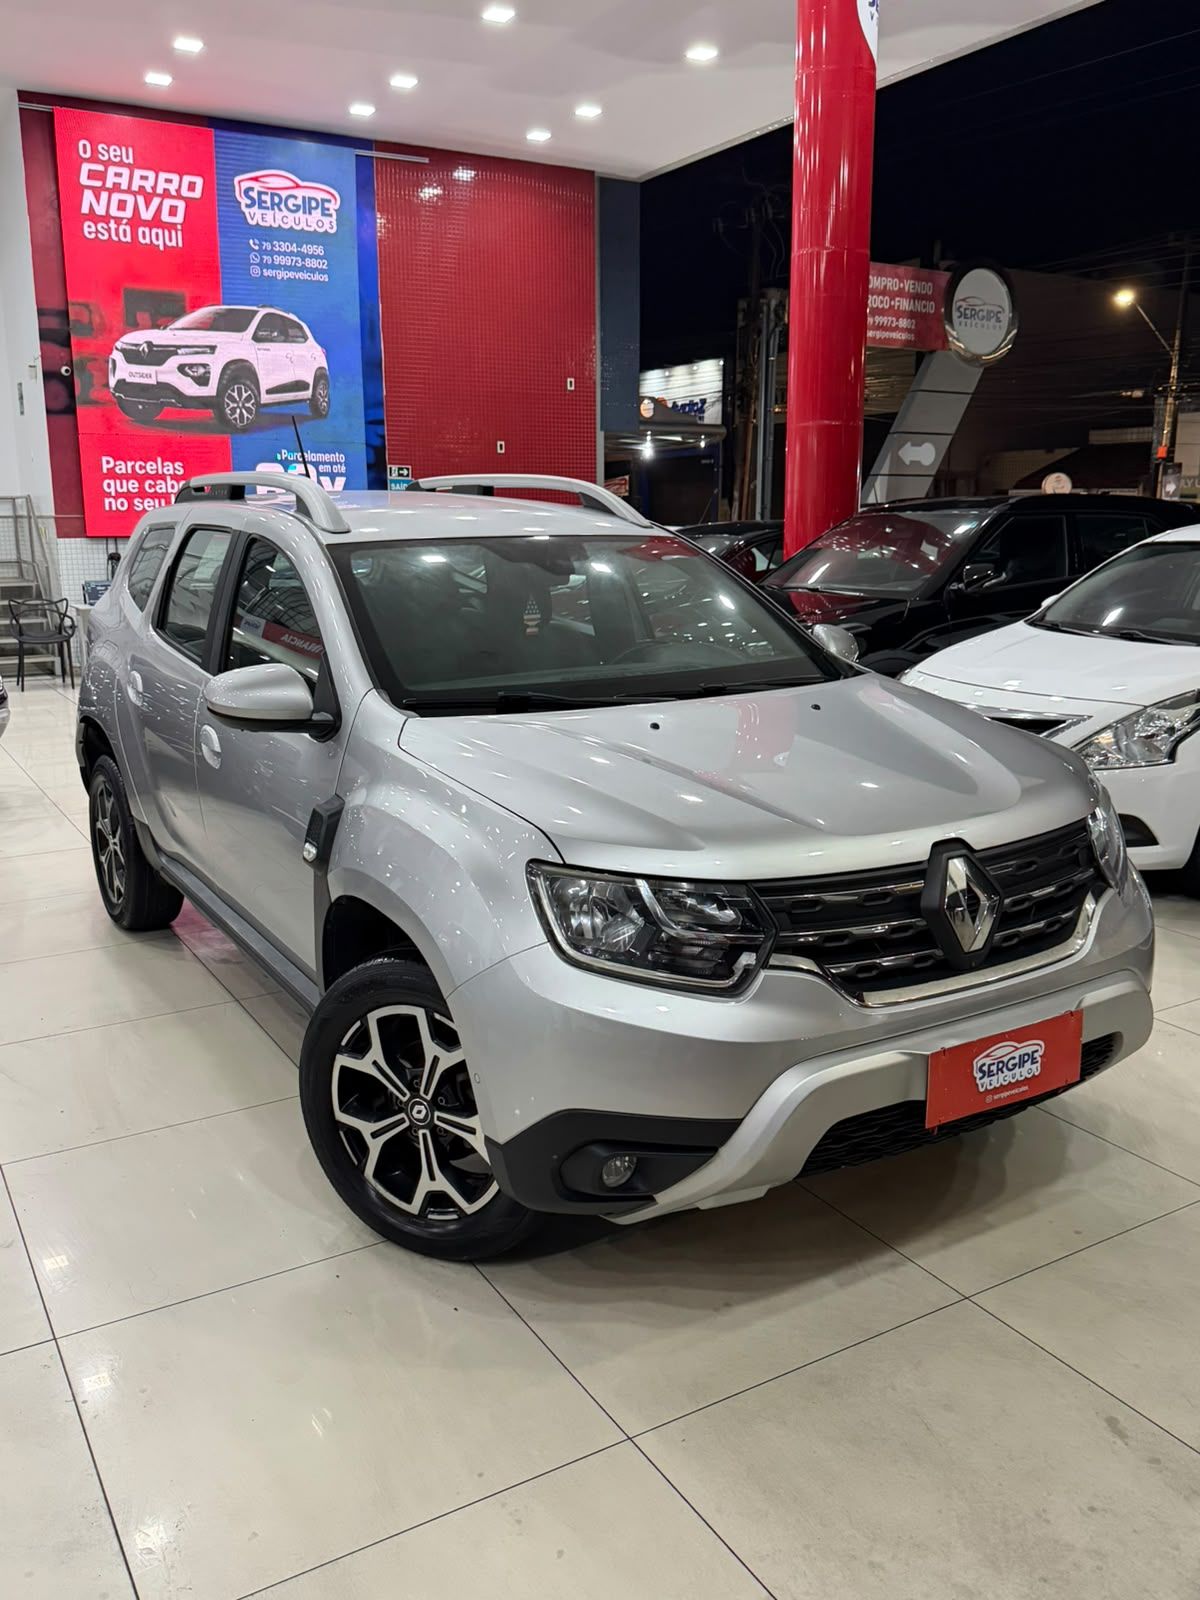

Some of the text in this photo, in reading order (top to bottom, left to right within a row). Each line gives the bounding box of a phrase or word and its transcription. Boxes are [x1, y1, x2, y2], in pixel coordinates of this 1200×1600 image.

[78, 139, 134, 164] O seu
[79, 162, 204, 199] CARRO
[81, 189, 186, 224] NOVO
[243, 186, 333, 218] SERGIPE
[83, 219, 183, 251] está aqui
[262, 241, 325, 256] 79 3304-4956
[262, 254, 328, 269] 79 99973-8802
[263, 267, 329, 282] sergipeveiculos
[868, 275, 933, 295] OMPRO VENDO
[868, 296, 935, 314] ROCO FINANCIO
[956, 305, 1002, 323] SERGIPE
[101, 455, 185, 475] Parcelas
[281, 449, 346, 463] Parcelamento
[318, 463, 346, 473] em até
[103, 479, 139, 496] que
[104, 497, 129, 511] no
[133, 497, 166, 511] seu
[978, 1049, 1039, 1080] SERGIPE
